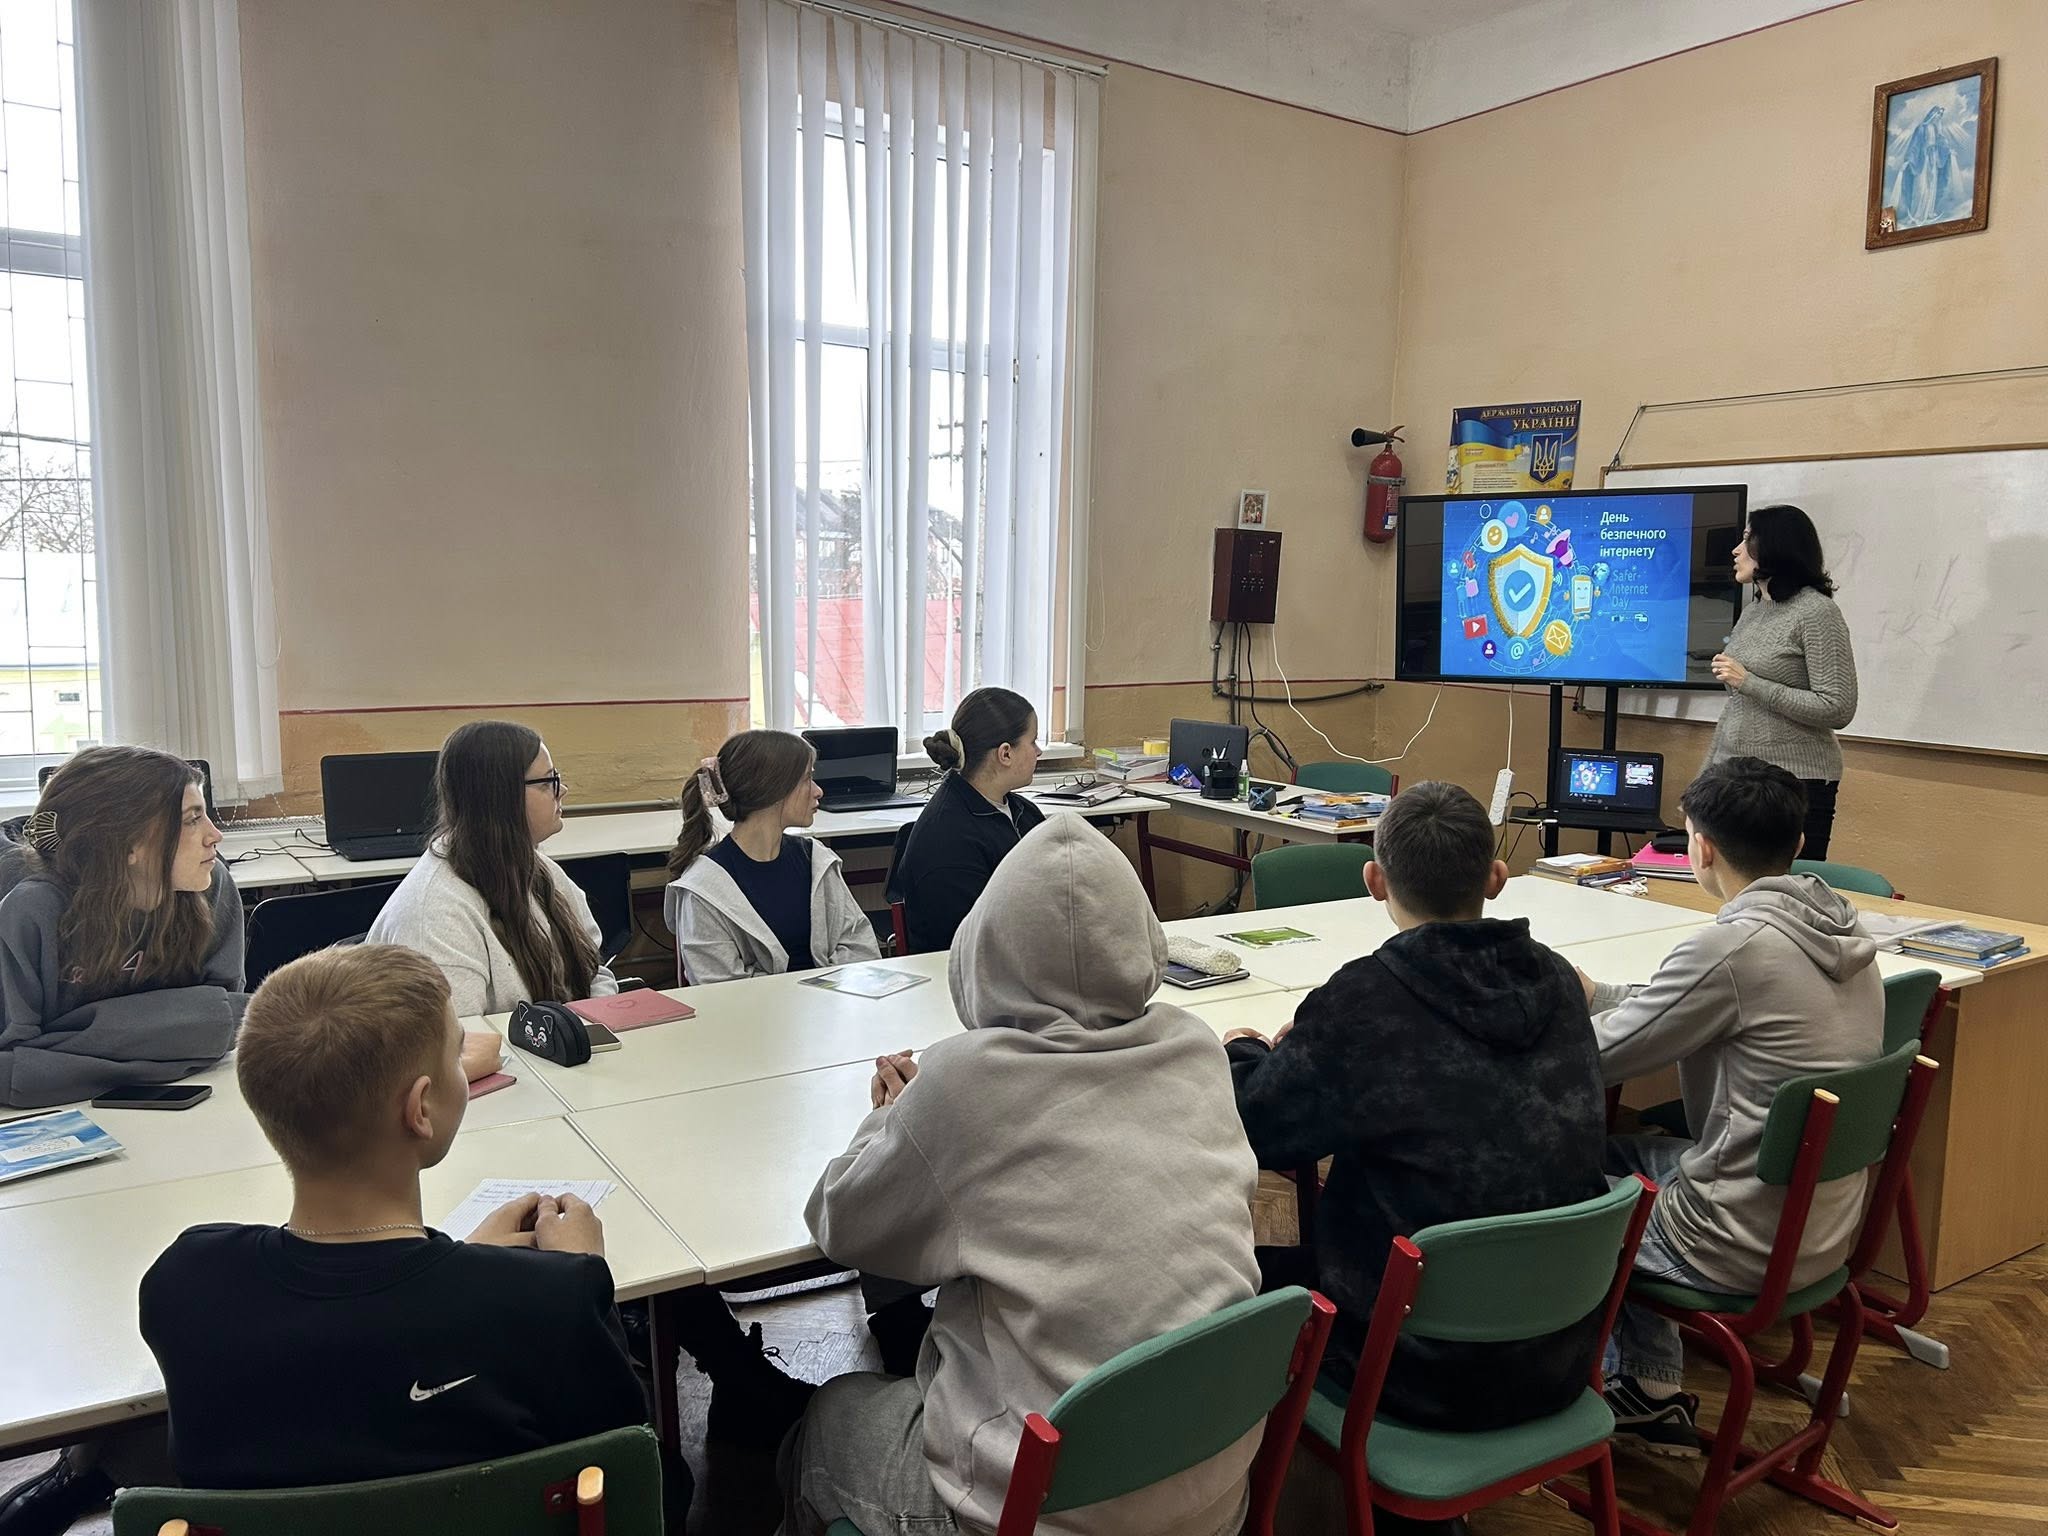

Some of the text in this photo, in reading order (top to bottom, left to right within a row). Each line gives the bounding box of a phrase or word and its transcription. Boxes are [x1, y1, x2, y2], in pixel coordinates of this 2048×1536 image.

[1481, 405, 1576, 418] ДЕРЖАВНІ СИМВОЛИ
[1514, 416, 1575, 430] УКРАЇНИ
[1600, 511, 1630, 526] День
[1600, 528, 1667, 540] безпечного
[1600, 545, 1655, 560] інтернету
[1613, 569, 1637, 582] Safer
[1611, 583, 1649, 595] Internet
[1612, 596, 1630, 610] Day
